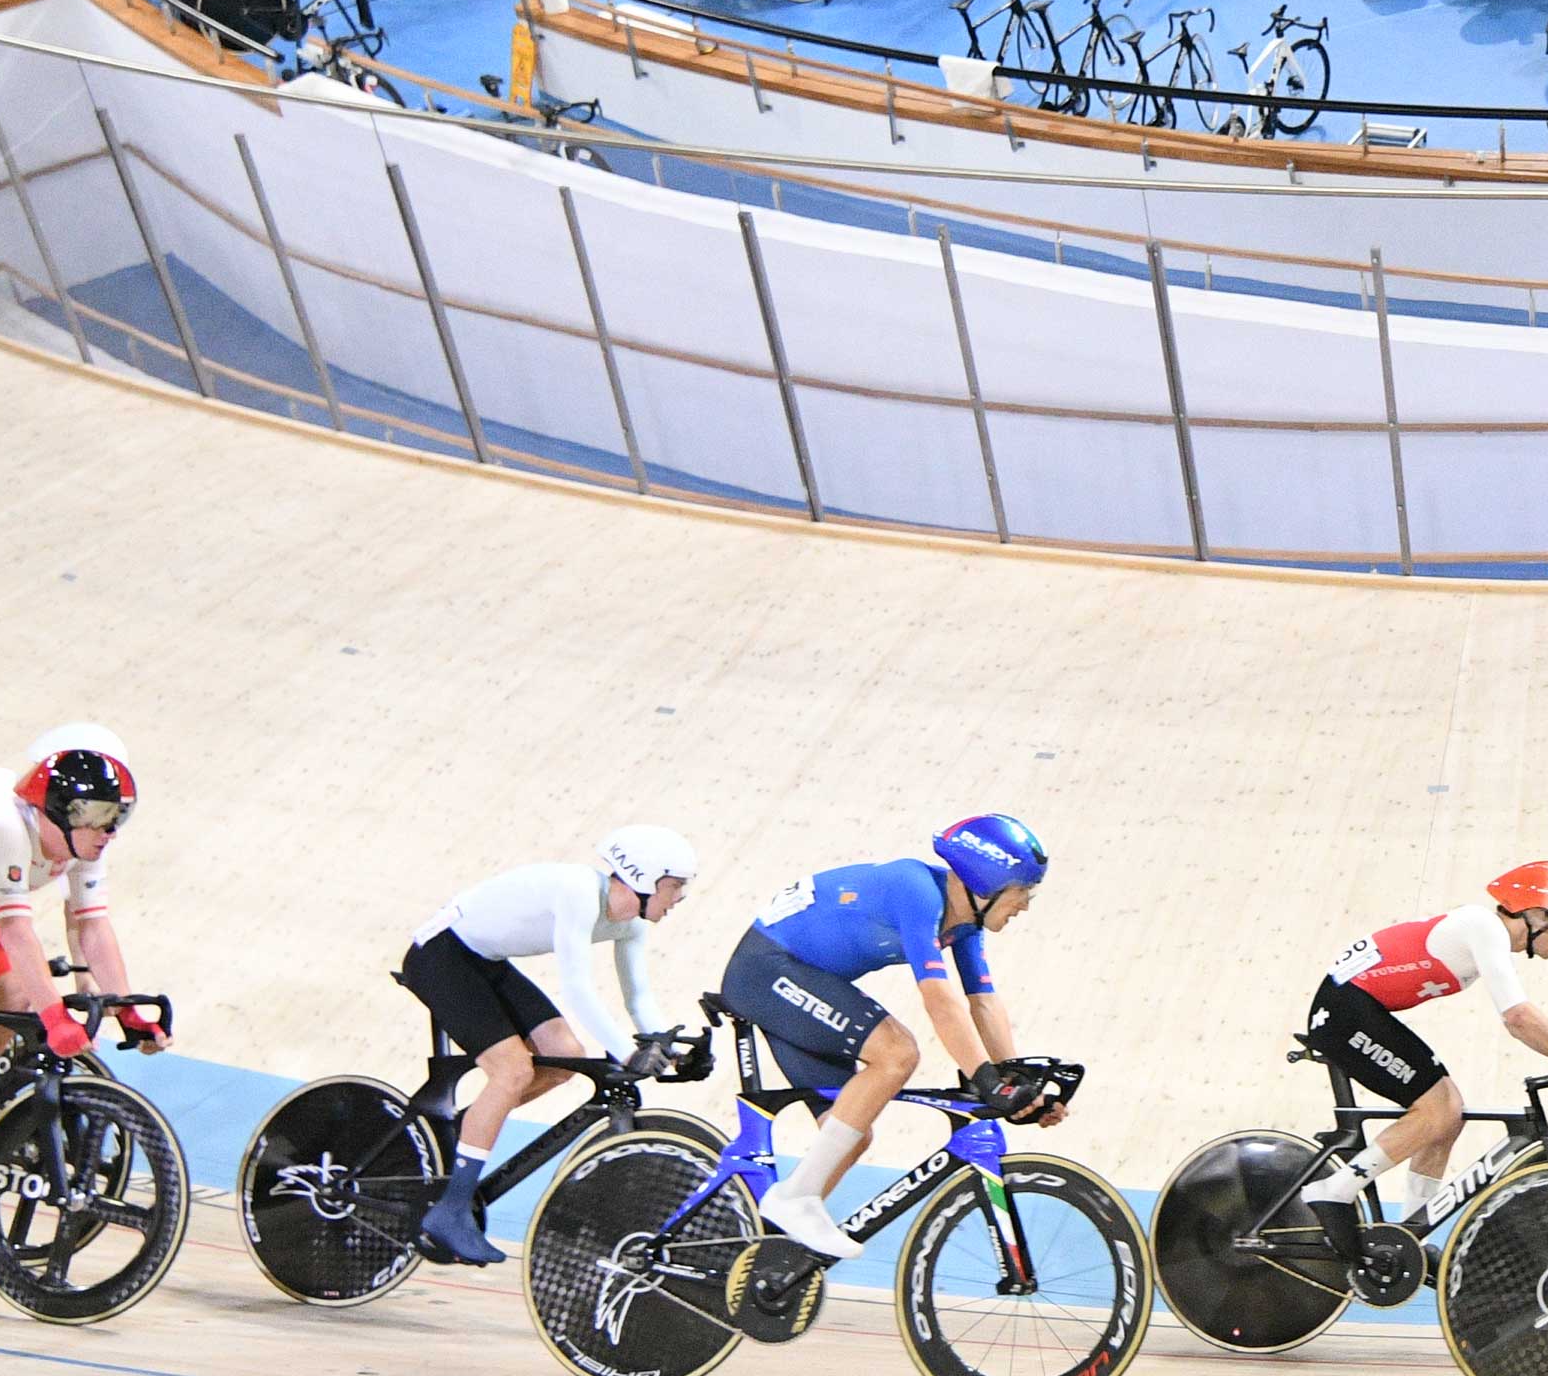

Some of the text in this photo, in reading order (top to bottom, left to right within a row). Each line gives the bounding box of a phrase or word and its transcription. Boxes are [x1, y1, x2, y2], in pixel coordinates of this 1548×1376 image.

[608, 843, 645, 884] KASK
[960, 829, 1019, 867] RUDY
[1372, 960, 1419, 978] TUDOR
[739, 1038, 754, 1078] ITALIA
[1348, 1031, 1416, 1084] EVIDEN
[841, 1150, 951, 1237] NARELLO
[1426, 1136, 1515, 1225] BMC
